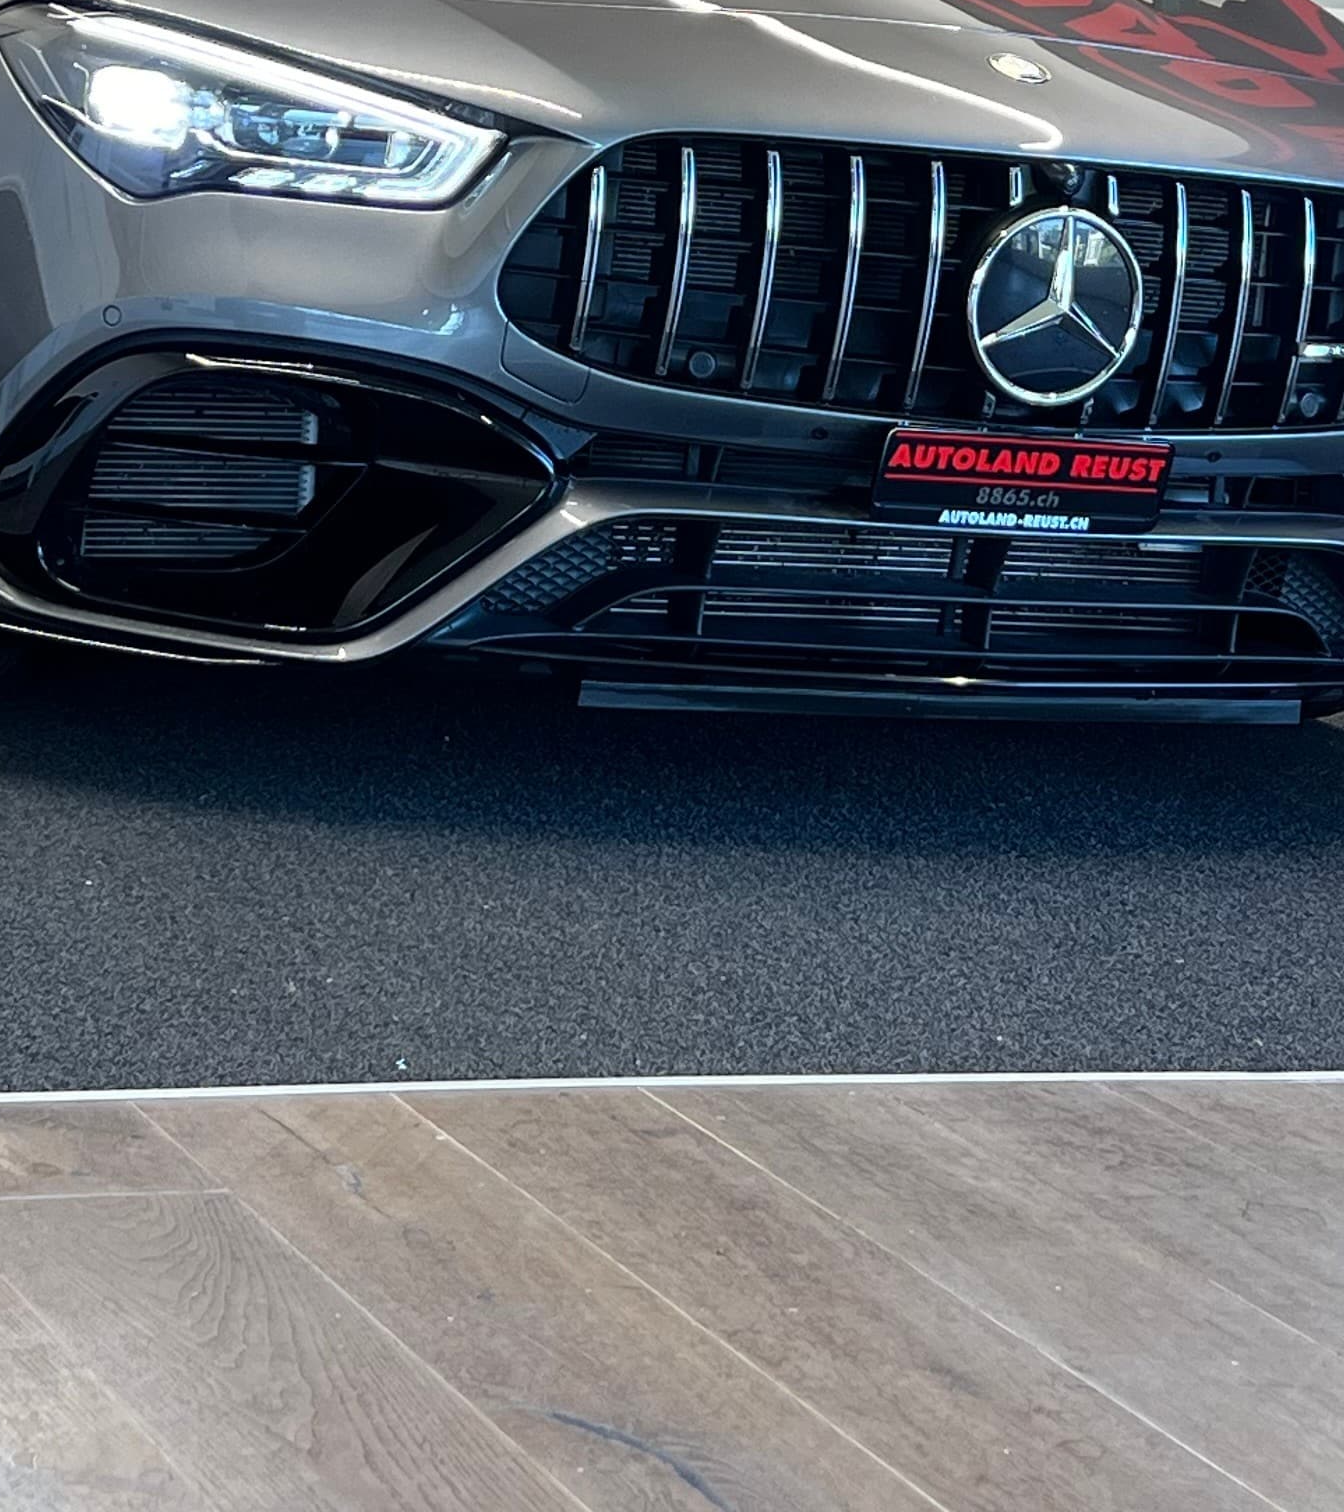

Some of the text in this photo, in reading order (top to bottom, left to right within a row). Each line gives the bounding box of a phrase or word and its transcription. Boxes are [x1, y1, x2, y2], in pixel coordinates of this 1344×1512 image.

[887, 442, 1167, 482] AUTOLAND REUST
[975, 486, 1060, 507] 8865.ch
[937, 509, 1090, 531] AUTOLAND-REUST.CH
